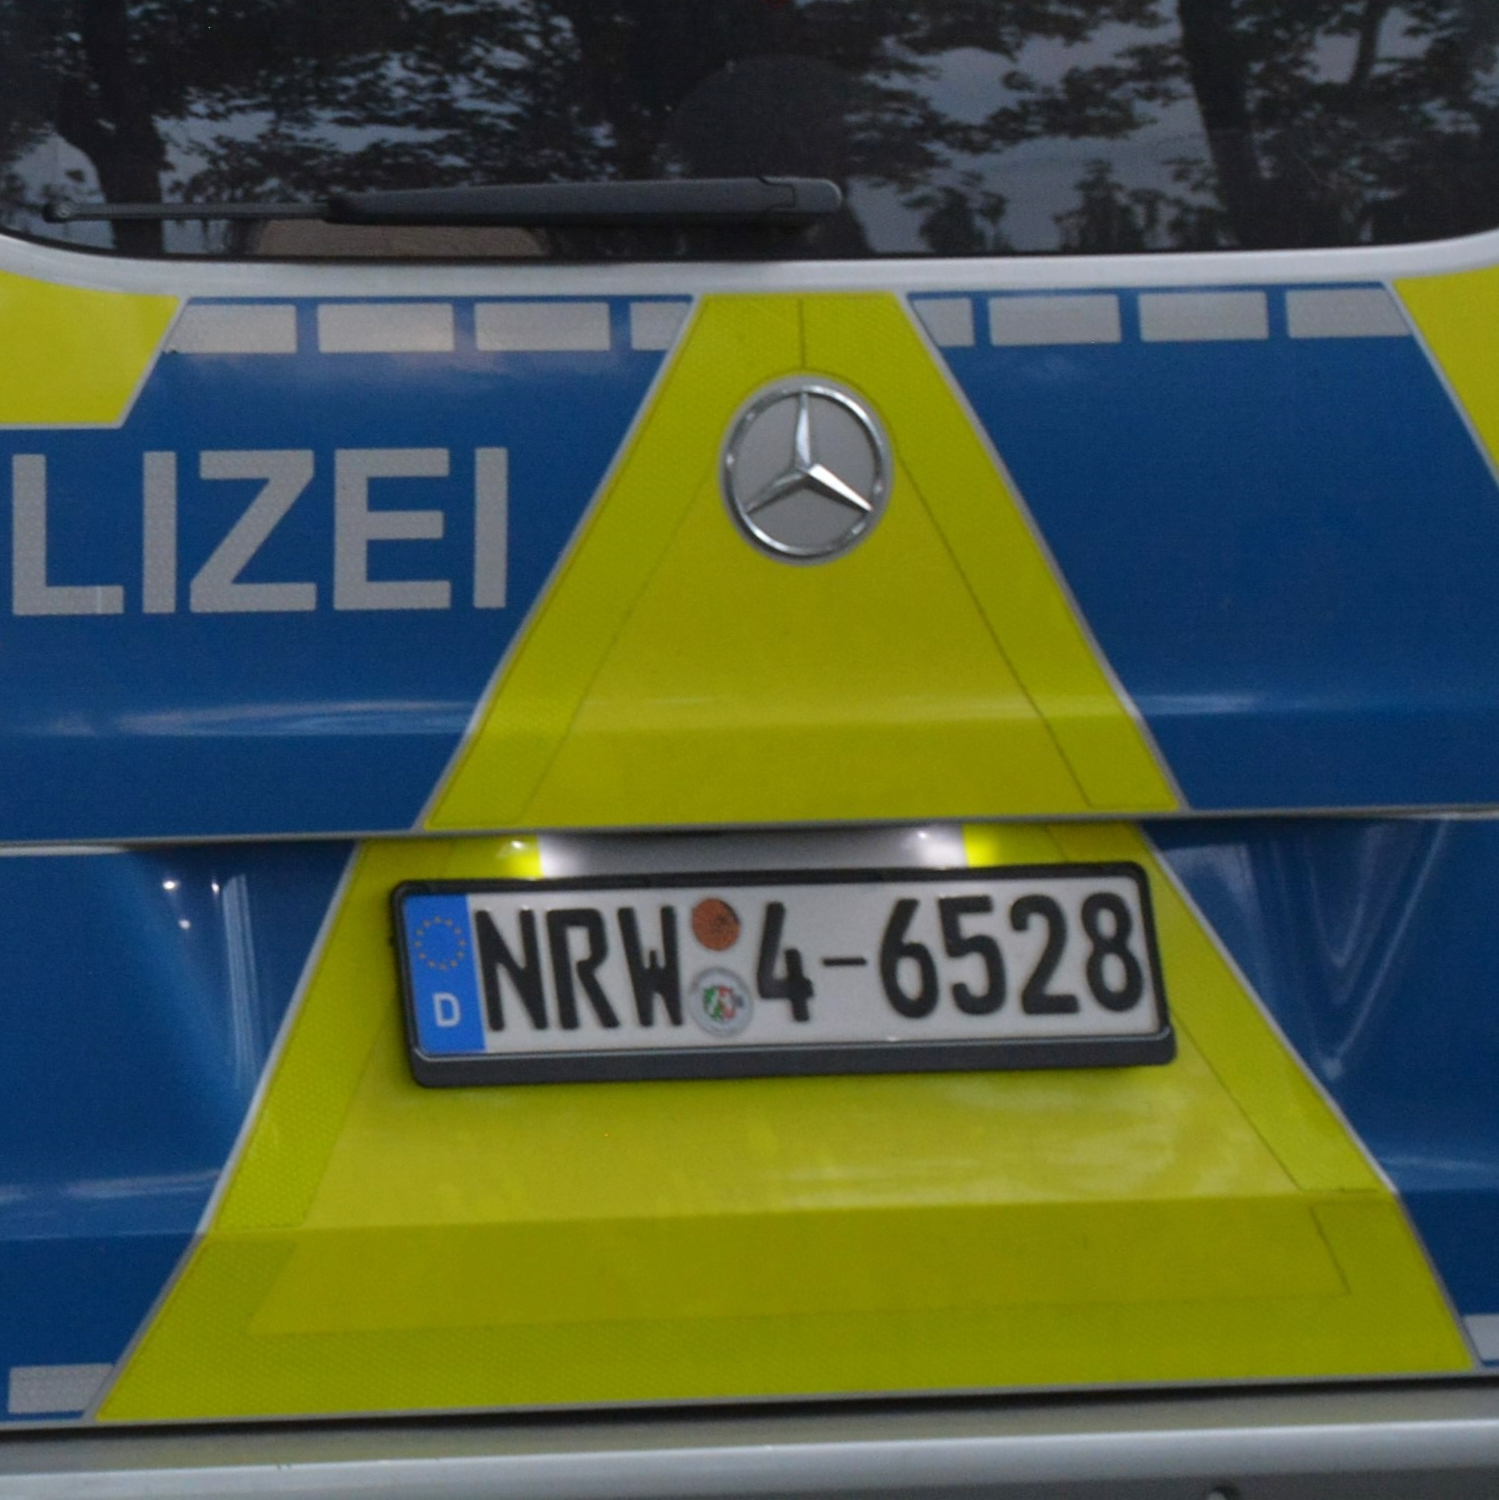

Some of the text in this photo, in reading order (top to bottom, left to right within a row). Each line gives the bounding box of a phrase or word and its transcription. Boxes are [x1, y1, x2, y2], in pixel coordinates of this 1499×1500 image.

[475, 891, 1145, 1032] NRW 4-6528
[433, 992, 461, 1028] D
